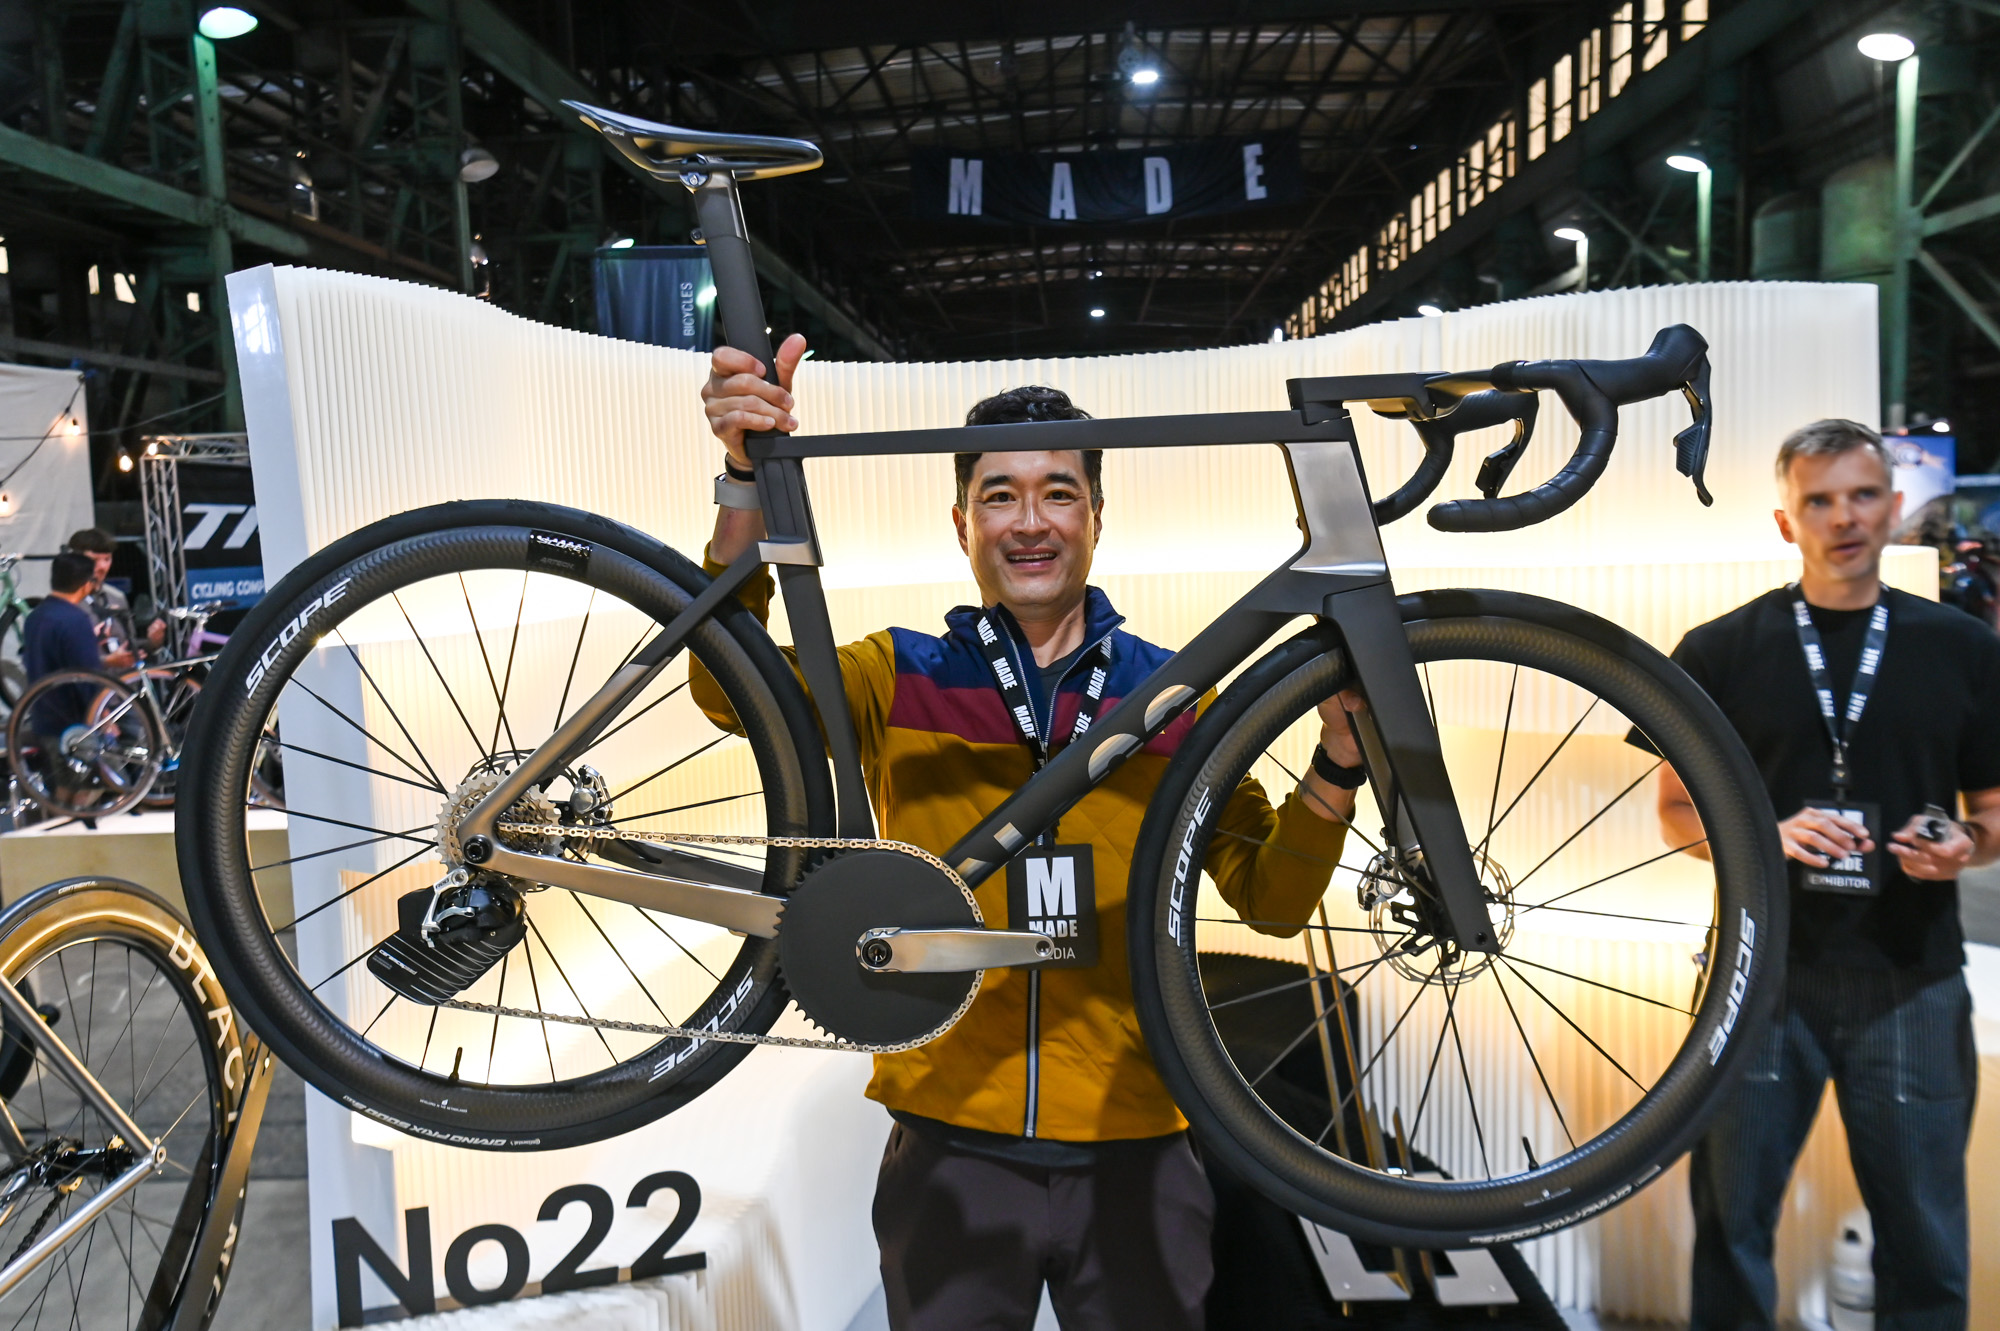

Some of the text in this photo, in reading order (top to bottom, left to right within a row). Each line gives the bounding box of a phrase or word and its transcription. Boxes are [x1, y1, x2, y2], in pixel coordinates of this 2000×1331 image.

[948, 143, 1267, 220] MADE
[680, 282, 696, 337] BICYCLES
[191, 581, 235, 600] CYCLING
[1869, 604, 1888, 631] MADE
[245, 577, 351, 699] SCOPE
[1804, 643, 1825, 671] MADE
[1858, 646, 1880, 675] MADE
[992, 656, 1018, 691] MADE
[1086, 666, 1107, 700] MADE
[1816, 689, 1836, 718] MADE
[1846, 691, 1867, 722] MADE
[1013, 704, 1037, 740] MADE
[1168, 786, 1212, 947] SCOPE
[1808, 873, 1870, 890] EXHIBITOR
[1025, 856, 1077, 917] M
[1028, 920, 1078, 938] MADE
[1708, 907, 1756, 1067] SCOPE
[648, 966, 754, 1084] SCOPE
[364, 1107, 411, 1129] 5000
[410, 1125, 451, 1140] PRIX
[449, 1135, 507, 1146] GRAND
[331, 1170, 707, 1329] No22
